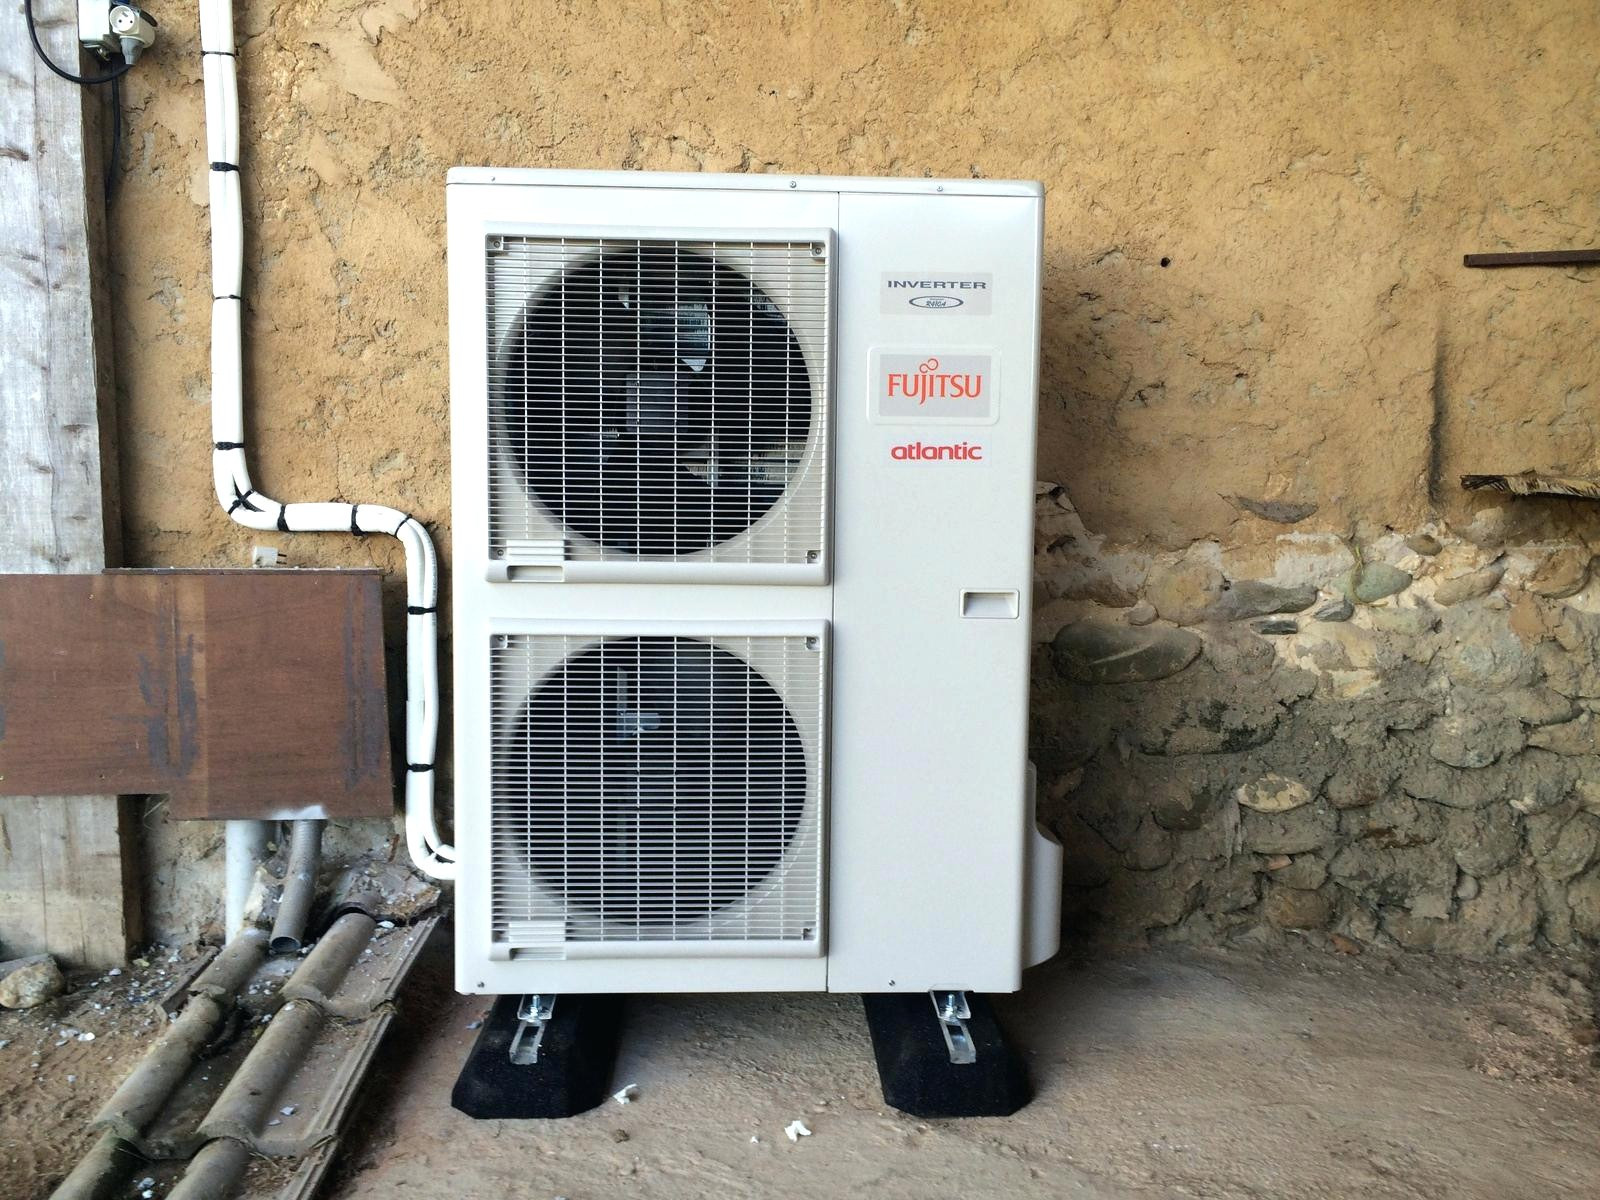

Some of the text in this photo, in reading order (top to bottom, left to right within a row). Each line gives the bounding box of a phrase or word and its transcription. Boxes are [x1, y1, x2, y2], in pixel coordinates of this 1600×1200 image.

[887, 280, 987, 289] INVERTER
[888, 358, 982, 405] FUJITSU
[891, 442, 982, 460] atlantic
